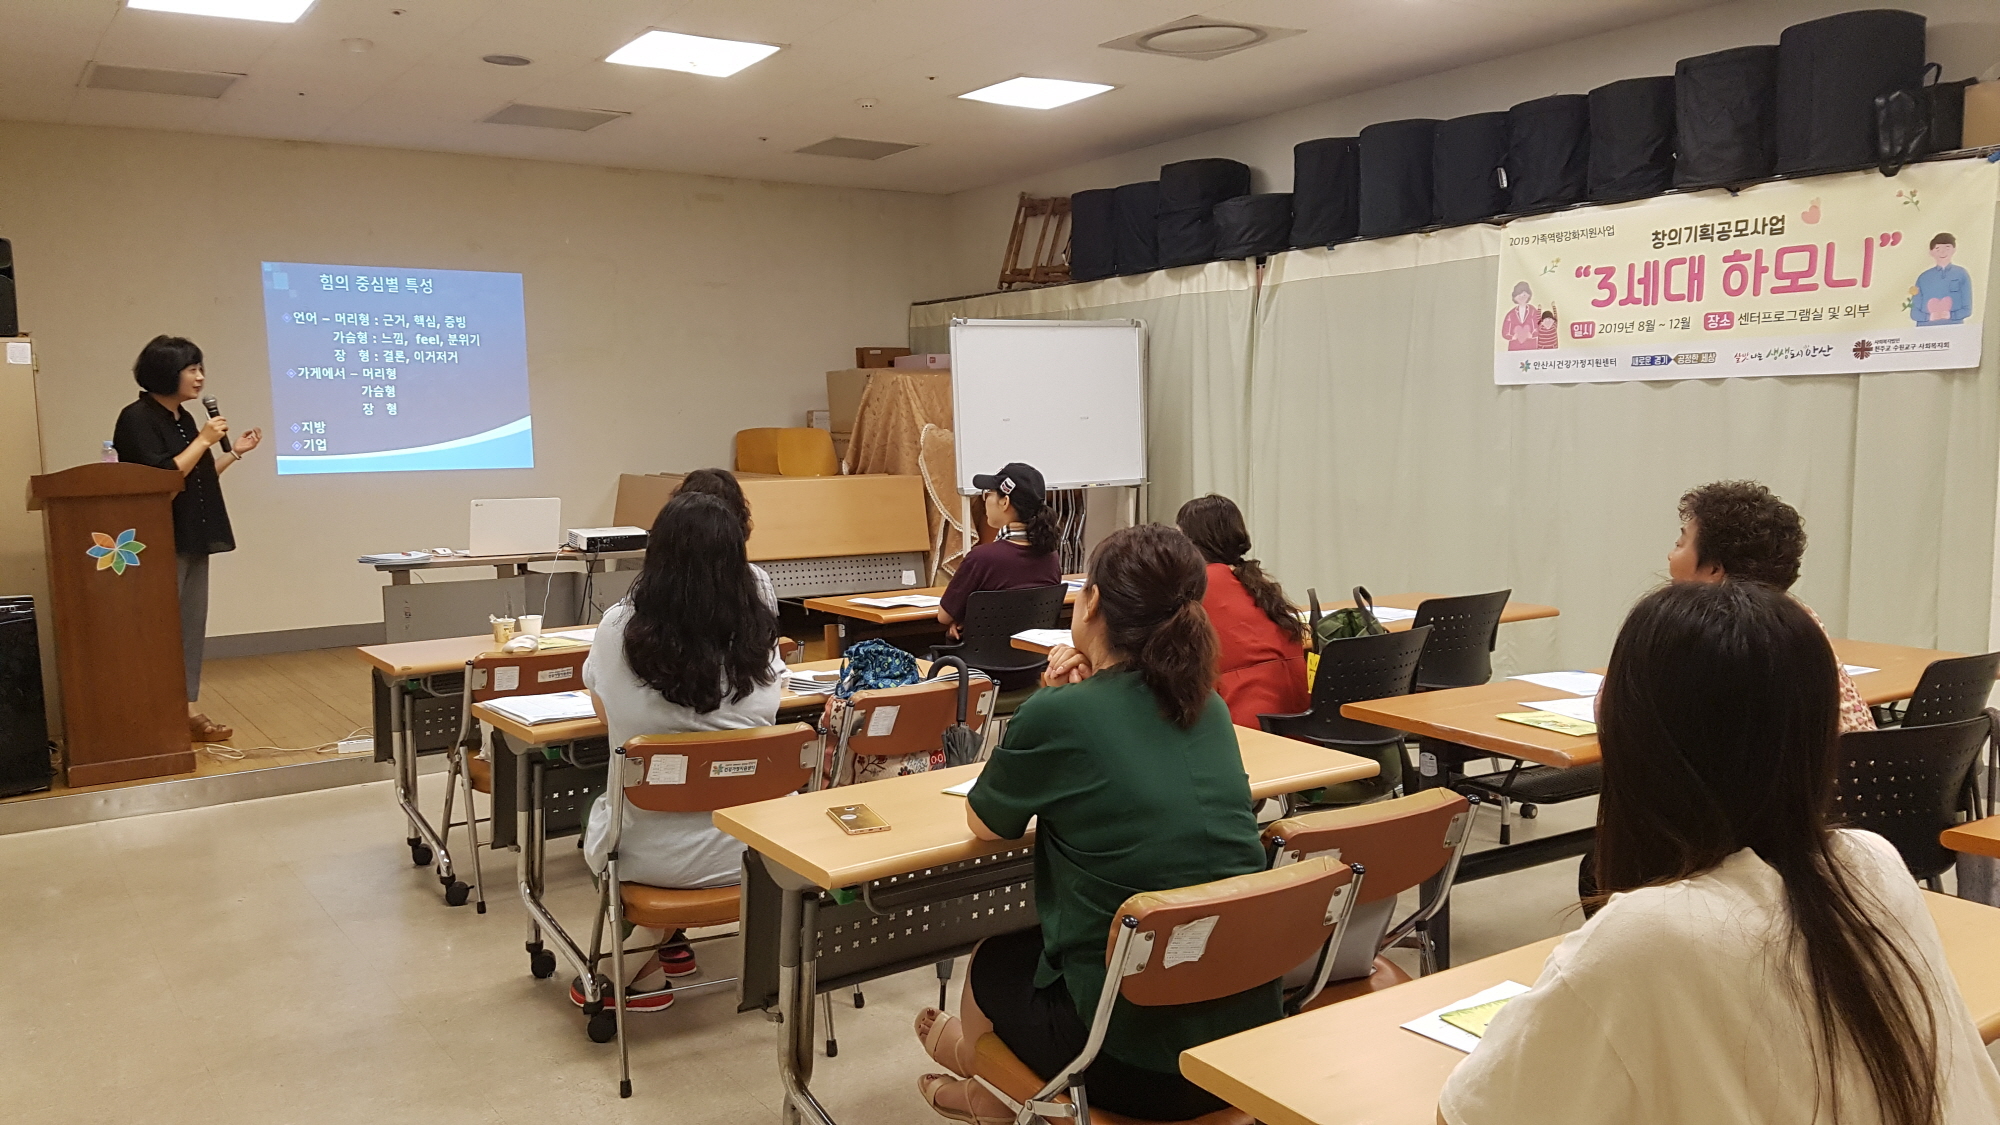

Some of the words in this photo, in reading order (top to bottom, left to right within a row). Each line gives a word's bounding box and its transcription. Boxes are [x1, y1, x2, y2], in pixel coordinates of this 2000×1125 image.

[1509, 236, 1530, 247] 2019
[1531, 225, 1615, 245] 가족역량강화지원사업
[1651, 214, 1786, 249] 창의기획공모사업
[319, 273, 349, 291] 힘의
[355, 275, 399, 294] 중심별
[405, 277, 433, 295] 특성
[293, 311, 318, 326] 언어
[334, 312, 370, 326] 머리형
[382, 313, 410, 329] 근거,
[413, 313, 441, 329] 핵심,
[444, 314, 466, 329] 증빙
[1572, 323, 1593, 338] 일시
[1598, 320, 1635, 334] 2019년
[1638, 319, 1656, 333] 8월
[1669, 316, 1691, 330] 12월
[1706, 314, 1732, 329] 장소
[1737, 306, 1824, 326] 센터프로그램실
[1828, 305, 1840, 320] 및
[1843, 303, 1870, 319] 외부
[333, 330, 368, 345] 가슴형
[381, 332, 409, 346] 느낌,
[415, 333, 444, 347] feel,
[447, 333, 480, 347] 분위기
[334, 349, 346, 362] 장
[359, 349, 370, 363] 형
[382, 349, 410, 364] 결론,
[413, 350, 458, 364] 이거저거
[1654, 354, 1668, 366] 경기
[1677, 353, 1699, 365] 공정한
[1700, 352, 1716, 363] 세상
[1804, 345, 1834, 358] 안산
[1533, 357, 1617, 370] 안산시건강가정지원센터
[297, 366, 346, 380] 가게에서
[362, 366, 397, 381] 머리형
[361, 384, 396, 398] 가슴형
[362, 402, 374, 415] 장
[386, 402, 398, 415] 형
[301, 421, 327, 434] 지방
[303, 438, 328, 452] 기업
